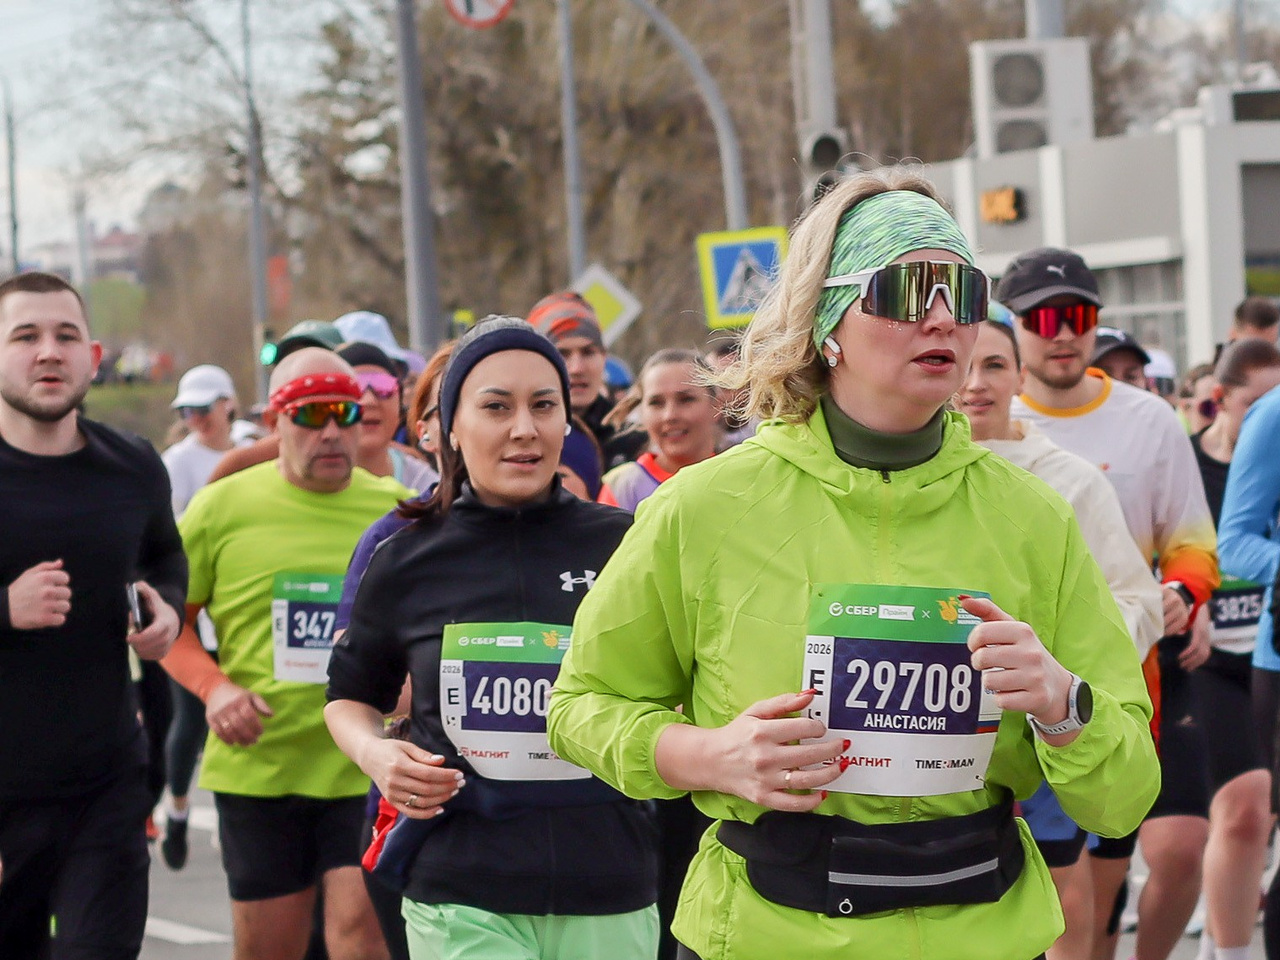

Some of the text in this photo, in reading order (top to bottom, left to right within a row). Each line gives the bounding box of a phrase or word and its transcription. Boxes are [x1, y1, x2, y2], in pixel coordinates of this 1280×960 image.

[845, 605, 877, 616] СБЕР
[293, 610, 336, 639] 347
[807, 643, 832, 655] 2026
[442, 665, 461, 674] 2026
[845, 658, 972, 713] 29708
[447, 687, 460, 705] E
[864, 713, 947, 731] АНАСТАСИЯ
[471, 750, 510, 759] МАГНИТ
